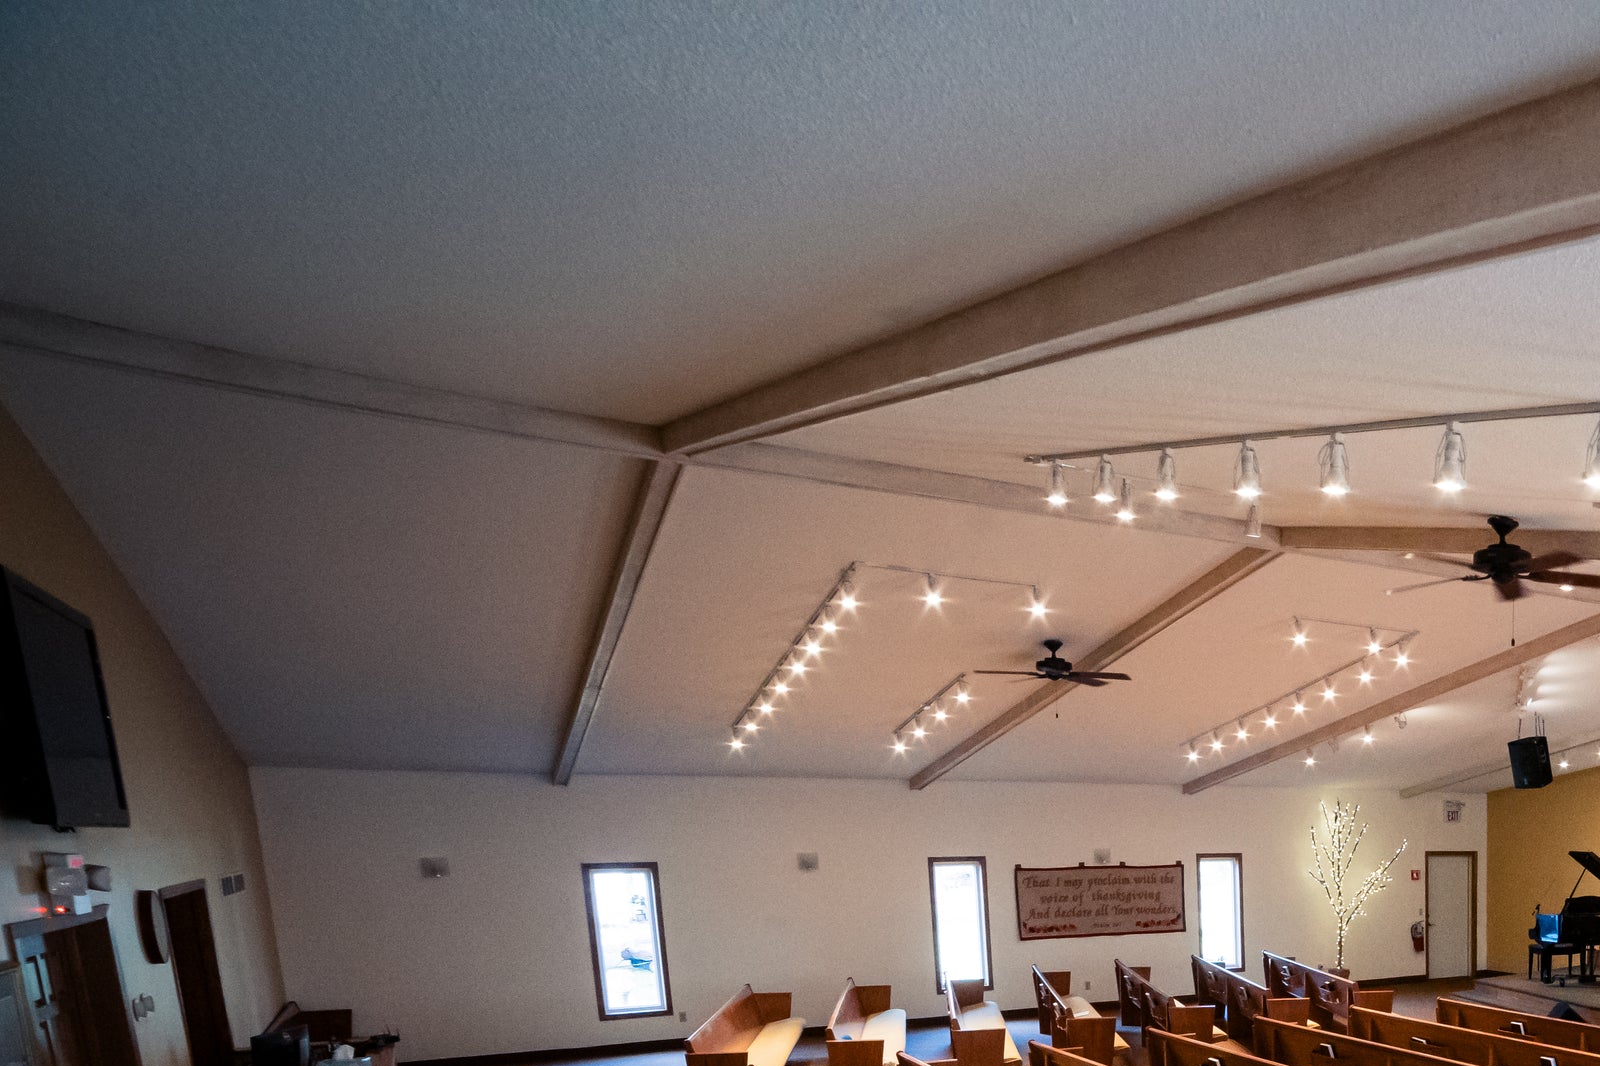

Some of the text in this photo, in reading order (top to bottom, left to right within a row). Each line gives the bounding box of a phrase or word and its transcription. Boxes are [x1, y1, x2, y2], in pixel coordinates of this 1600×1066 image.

[1447, 811, 1459, 821] EXIT
[1022, 876, 1049, 888] That
[1063, 879, 1083, 889] may
[1088, 873, 1130, 891] proclaim
[1133, 873, 1156, 884] with
[1041, 889, 1160, 906] voice of thanksgiving
[1025, 907, 1051, 920] And
[1055, 905, 1092, 918] declare
[1095, 904, 1109, 916] all
